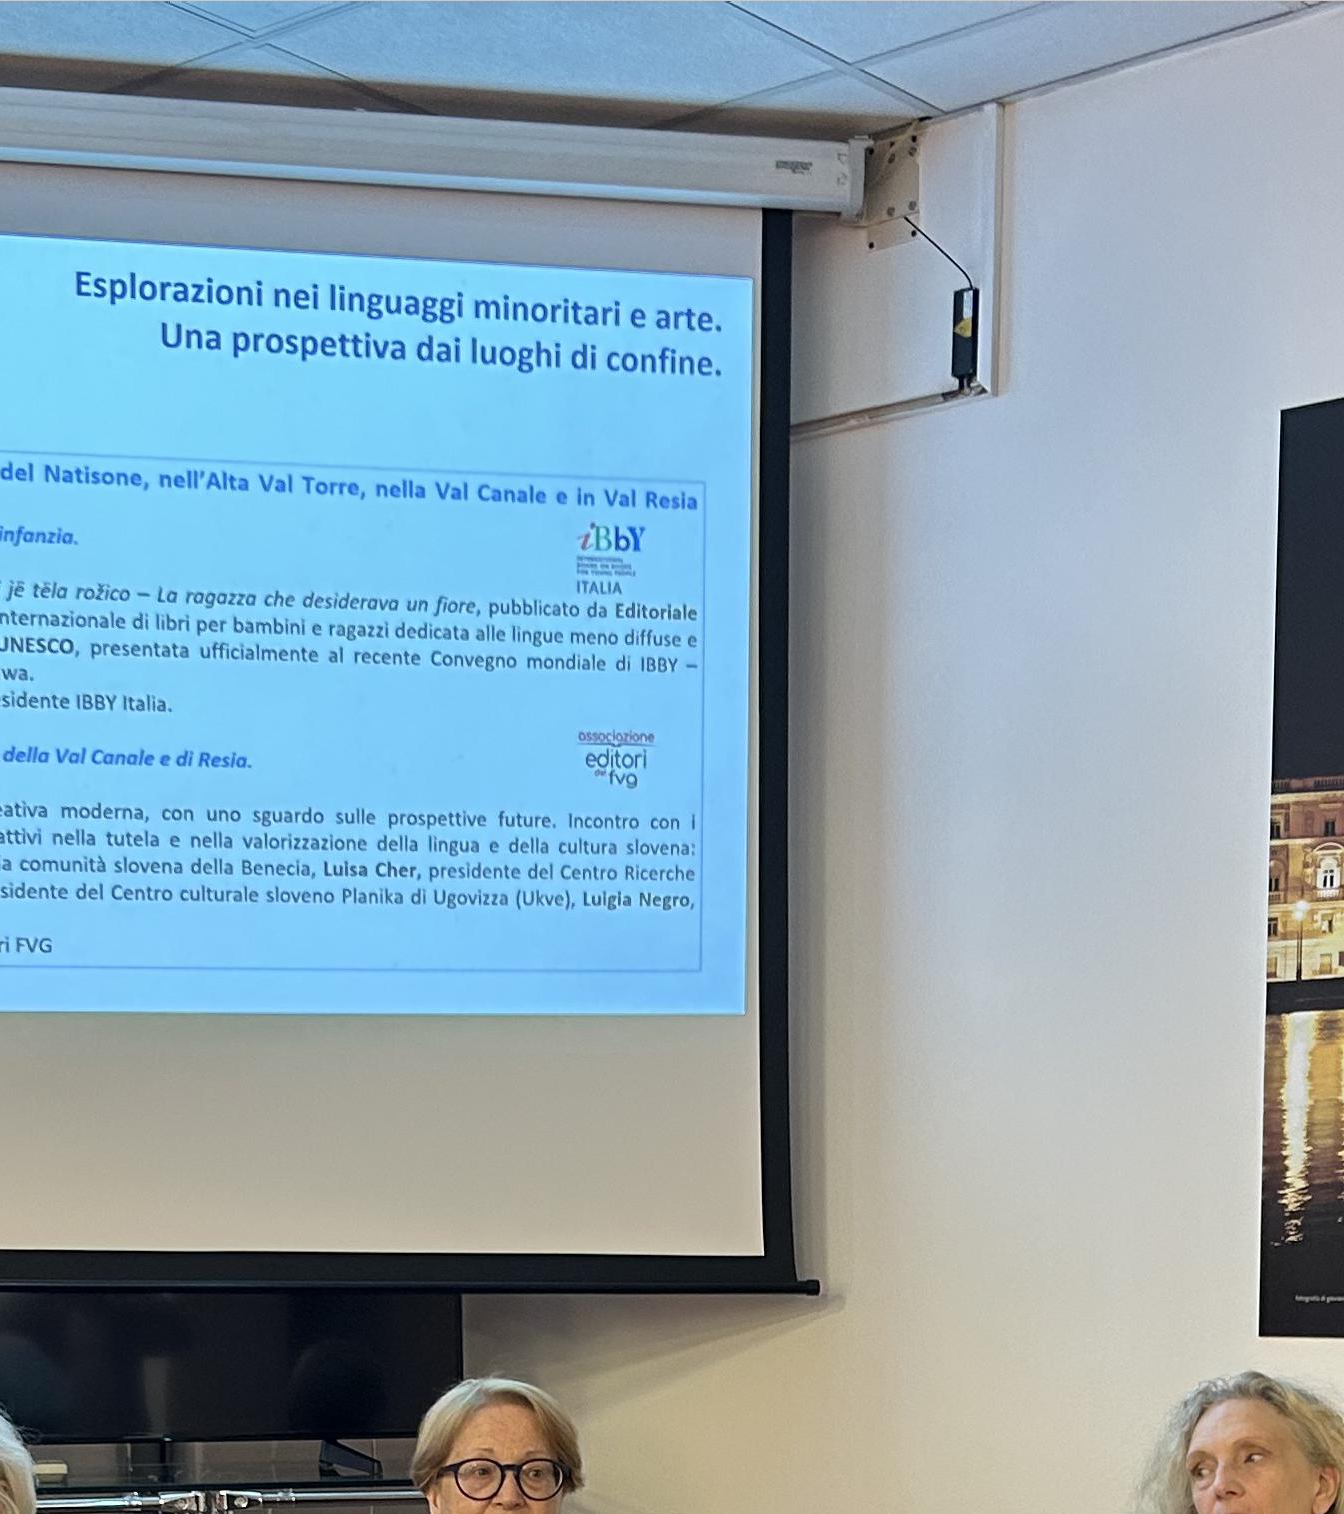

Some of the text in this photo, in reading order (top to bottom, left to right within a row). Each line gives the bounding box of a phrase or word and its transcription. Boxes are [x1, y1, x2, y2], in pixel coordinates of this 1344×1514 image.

[75, 270, 722, 333] Esplorazioni nei linguaggi minoritari e arte.
[160, 321, 722, 377] Una prospettiva dai luoghi di confine.
[0, 460, 34, 483] del
[43, 463, 150, 491] Natisone,
[258, 473, 293, 494] Val
[300, 475, 366, 501] Torre,
[375, 478, 426, 499] nella
[434, 481, 469, 501] Val
[477, 483, 547, 505] Canale
[555, 490, 568, 505] e
[577, 487, 596, 507] in
[603, 488, 637, 509] Val
[645, 490, 698, 511] Resia
[577, 581, 622, 595] ITALIA
[75, 693, 117, 712] IBBY
[122, 694, 173, 713] Italia.
[2, 745, 51, 764] della
[54, 746, 87, 765] Val
[90, 748, 156, 767] Canale
[158, 754, 172, 767] e
[175, 749, 195, 768] di
[197, 751, 253, 769] Resia.
[585, 748, 647, 769] editori
[609, 769, 638, 789] fvg
[15, 936, 53, 954] FVG
